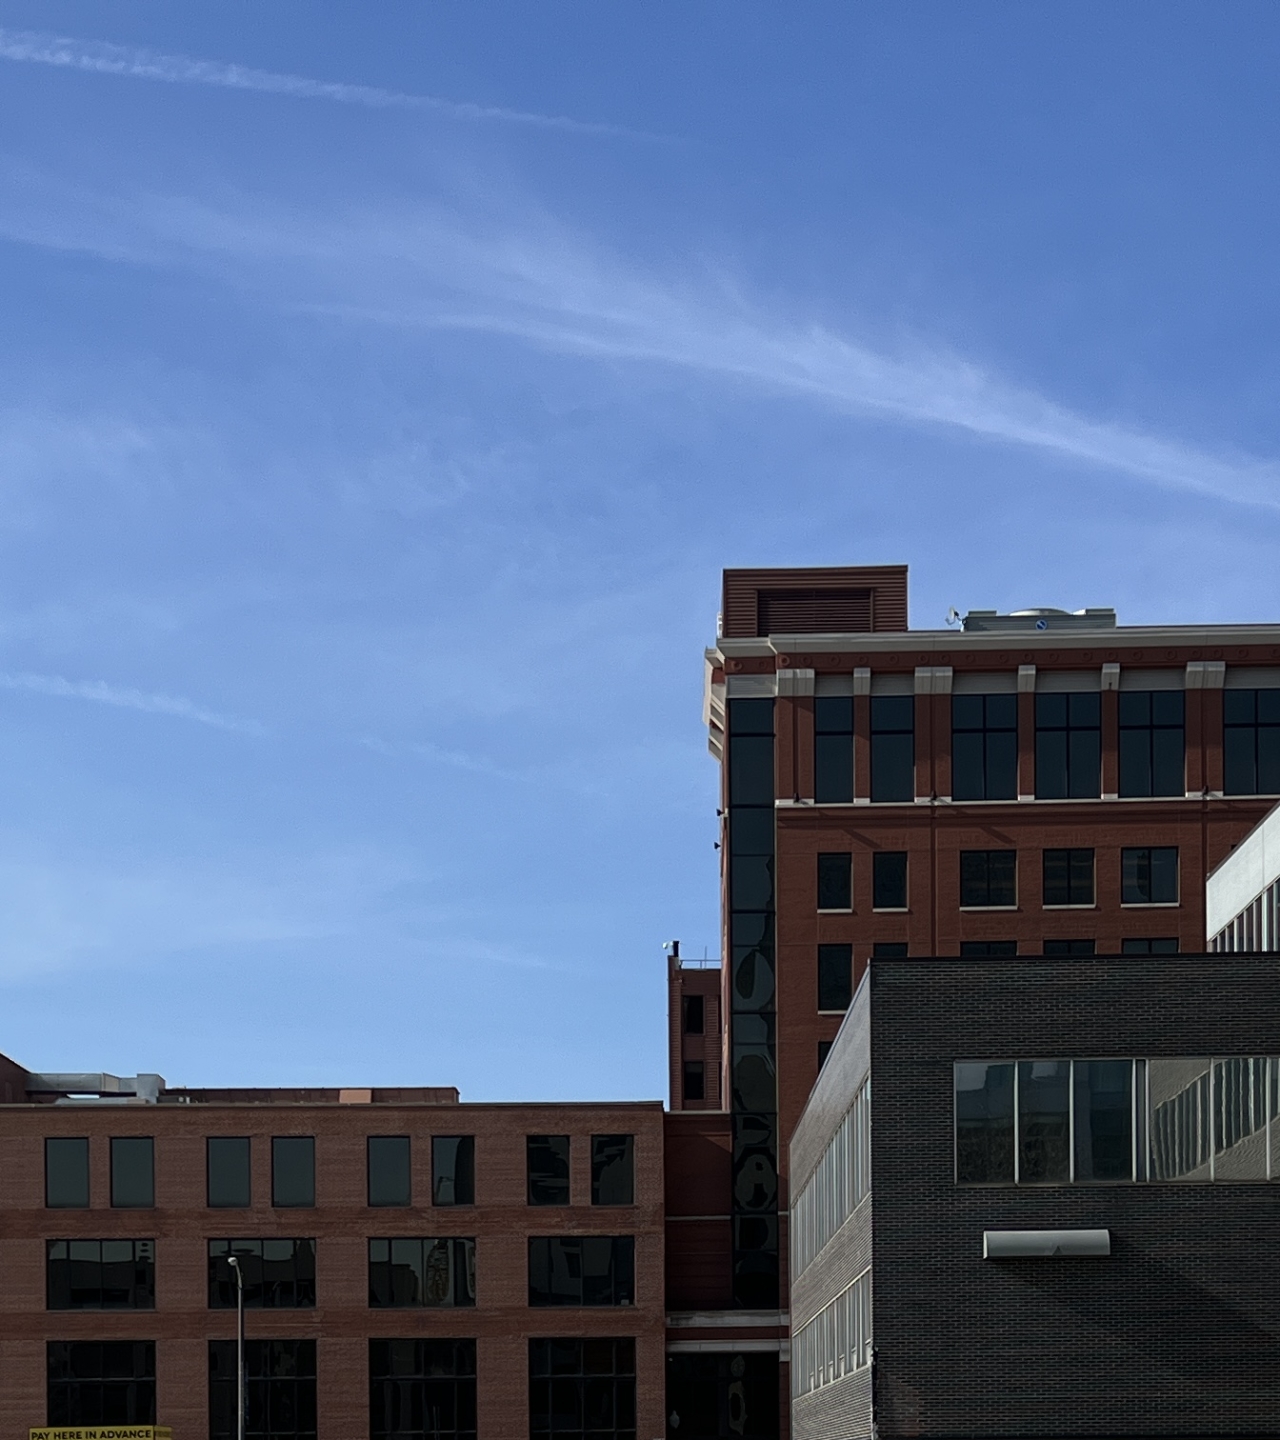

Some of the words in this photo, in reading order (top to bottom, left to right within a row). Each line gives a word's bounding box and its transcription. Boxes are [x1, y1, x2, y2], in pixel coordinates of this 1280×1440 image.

[31, 1432, 51, 1440] PAY
[53, 1431, 83, 1440] HERE
[85, 1430, 97, 1440] IN
[99, 1429, 152, 1439] ADVANCE
